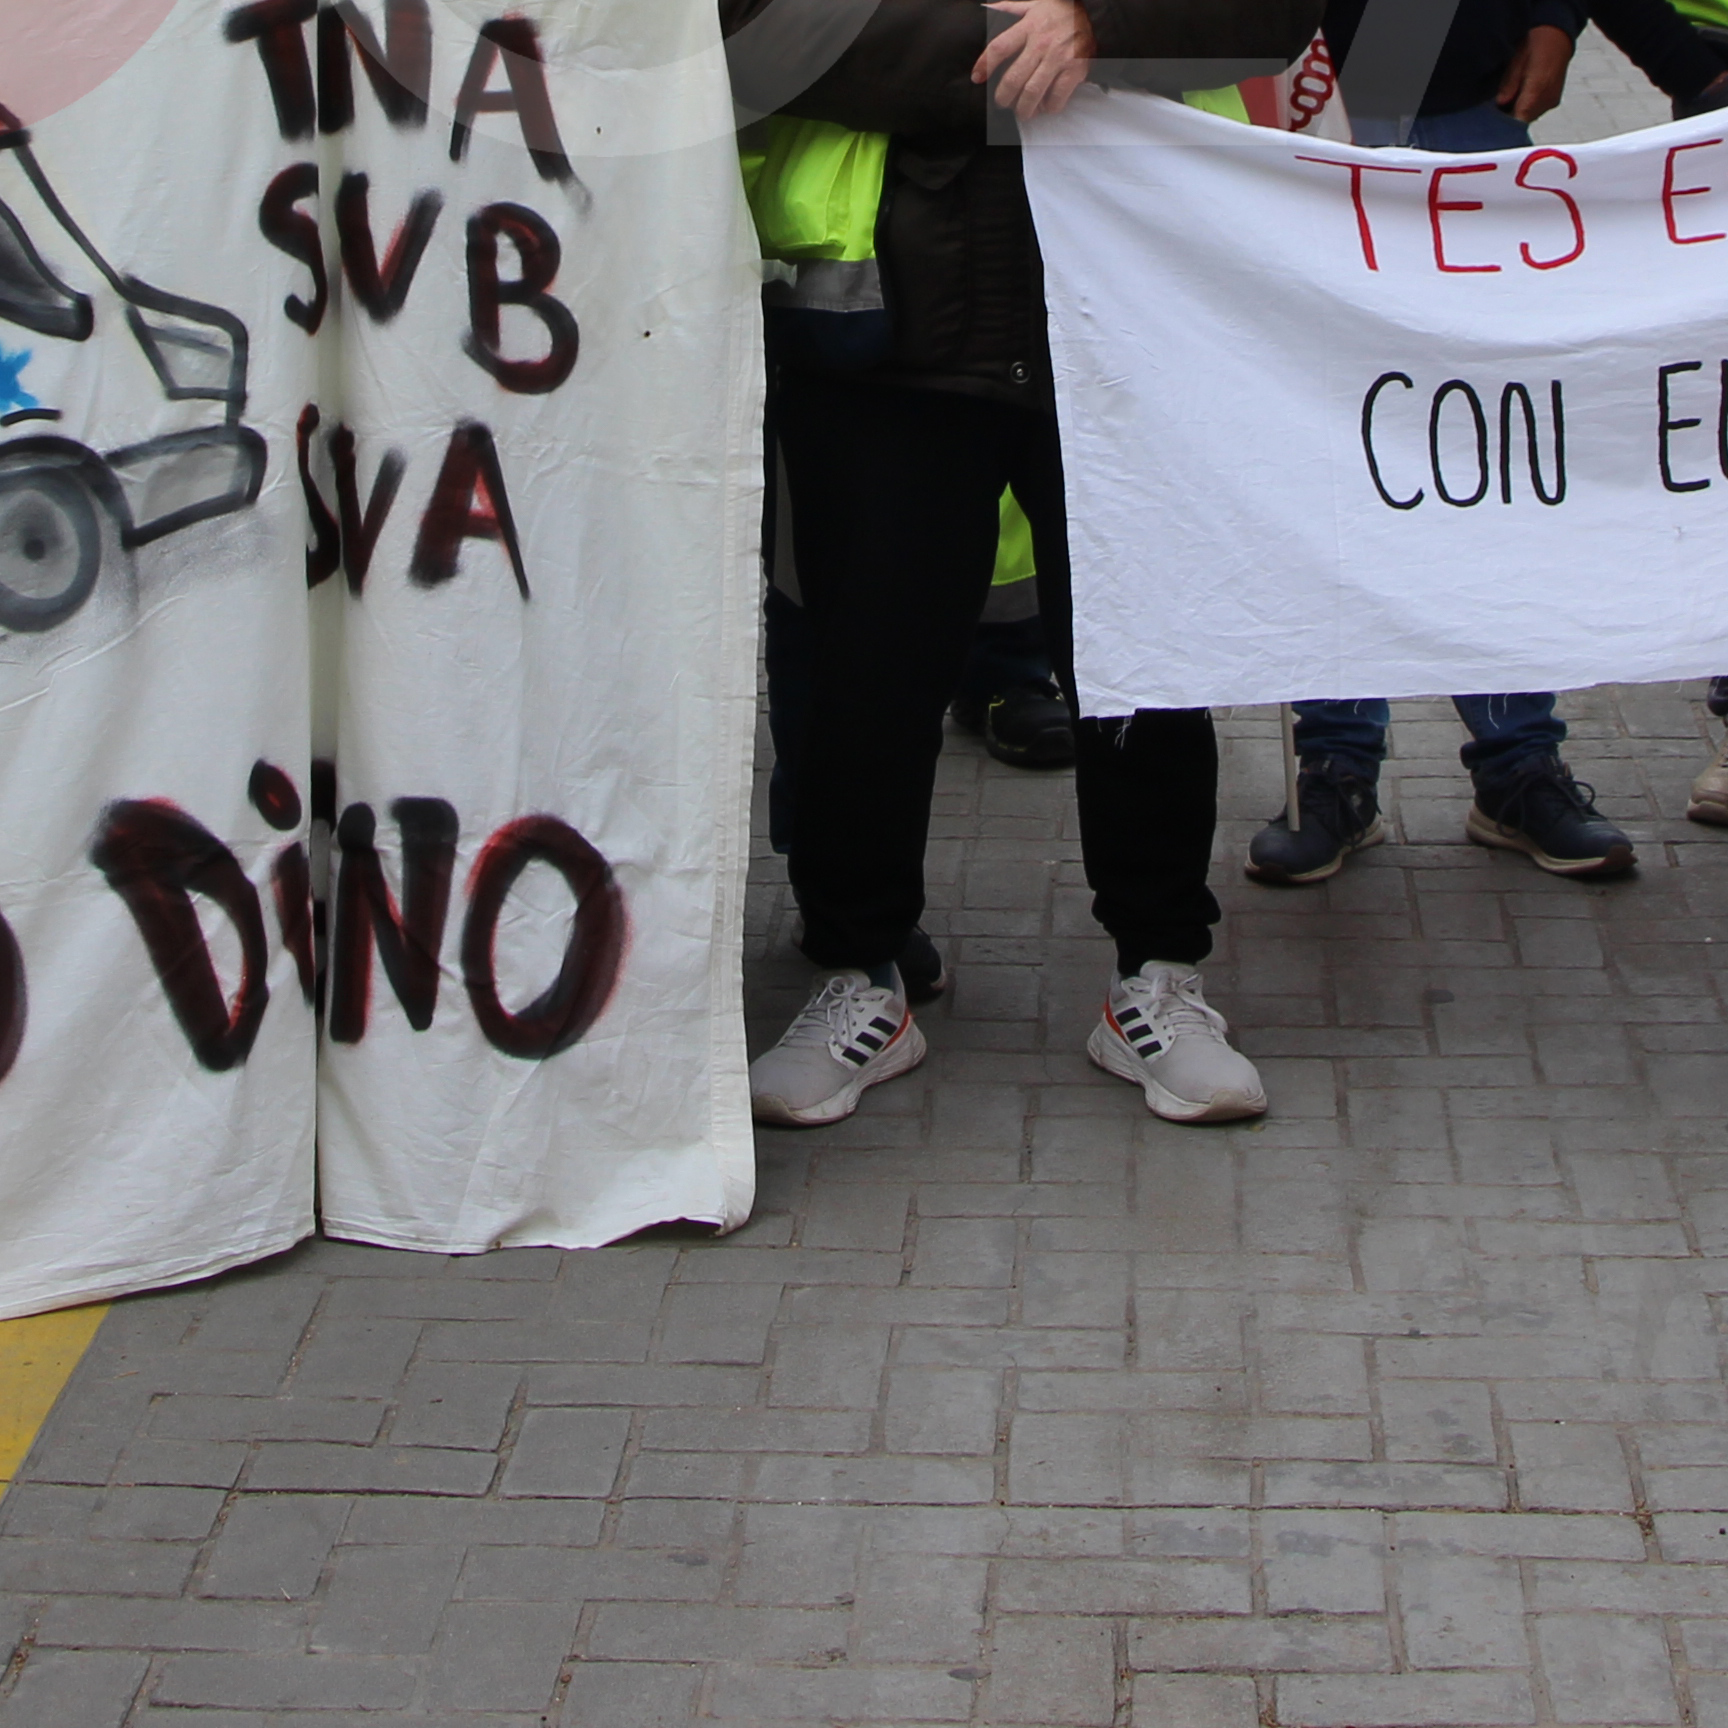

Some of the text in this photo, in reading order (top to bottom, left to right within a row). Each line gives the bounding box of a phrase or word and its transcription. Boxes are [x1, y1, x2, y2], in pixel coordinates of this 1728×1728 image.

[259, 162, 580, 395] SVB
[1294, 148, 1585, 272] TES
[1362, 371, 1566, 510] CON
